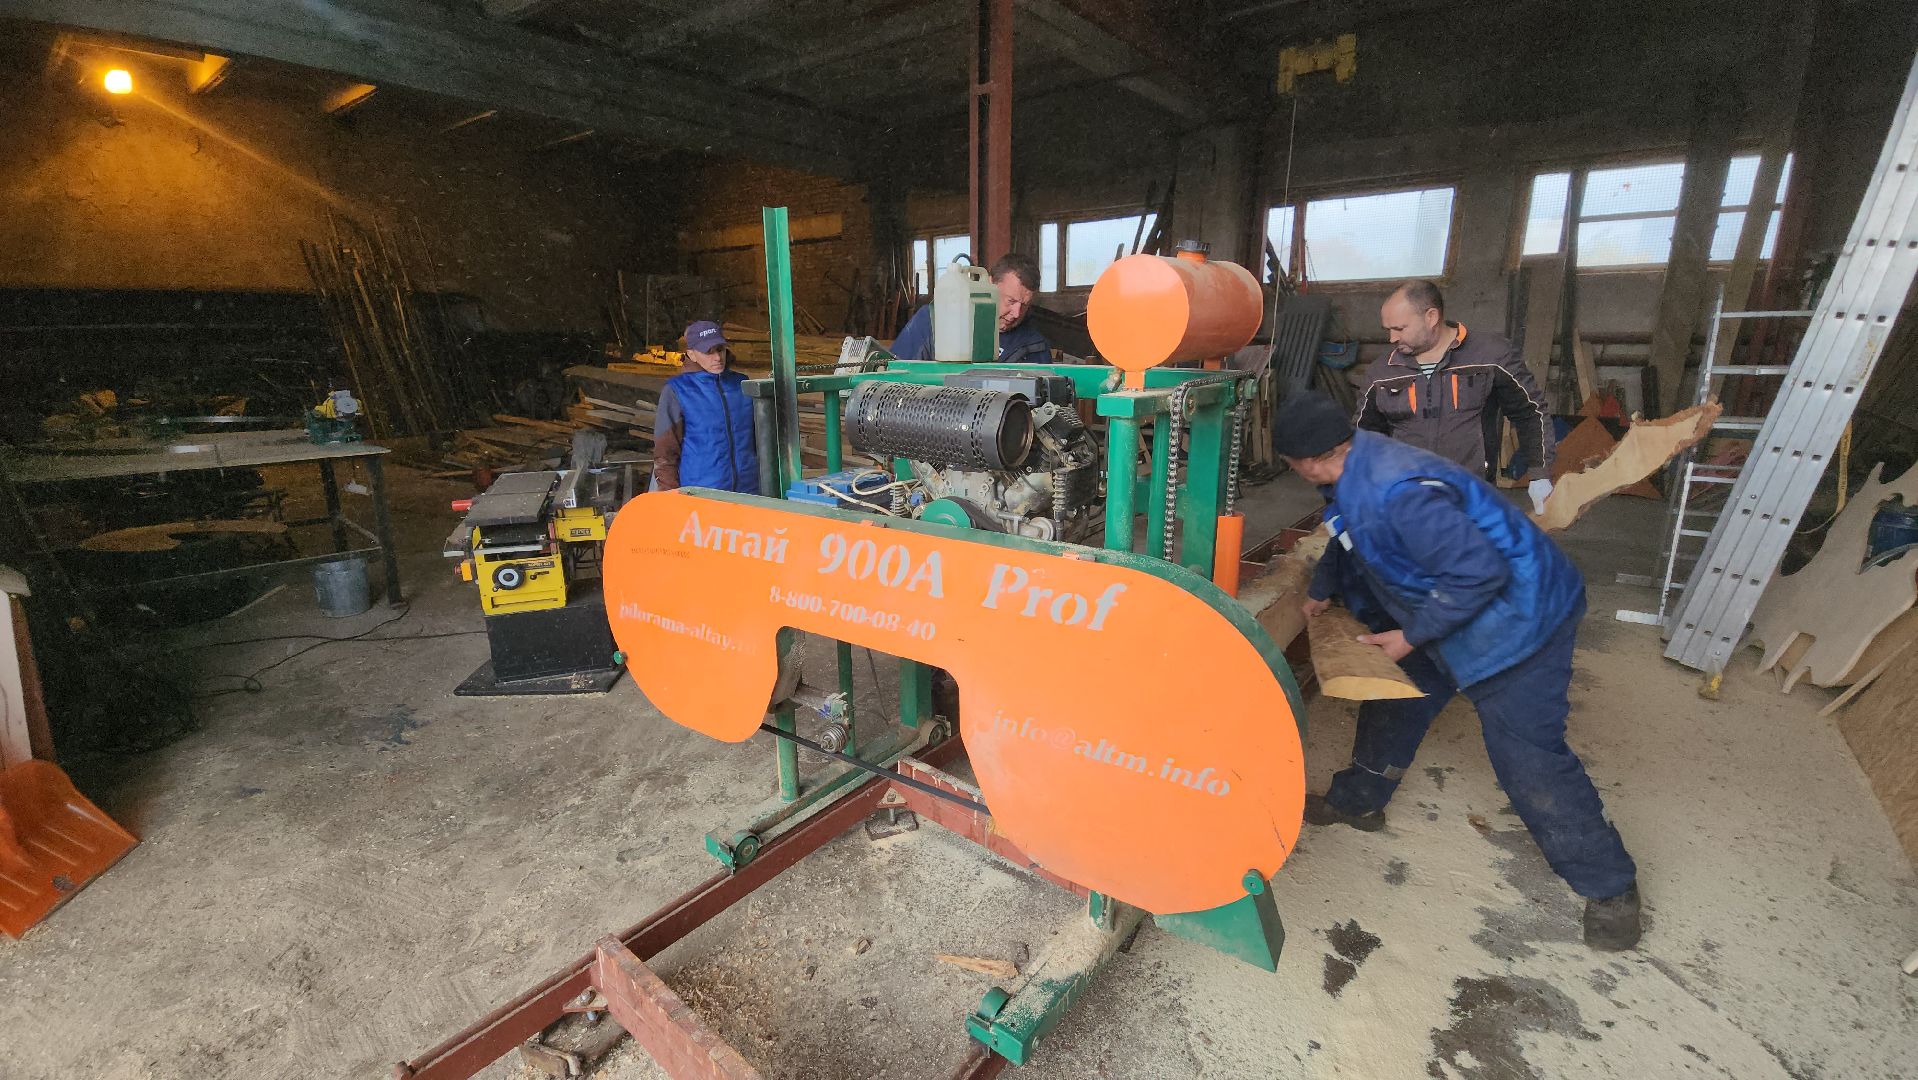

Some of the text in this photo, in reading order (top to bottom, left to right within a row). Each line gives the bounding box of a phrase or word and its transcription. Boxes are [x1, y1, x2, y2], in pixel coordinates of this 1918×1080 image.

[678, 510, 790, 564] Алтай
[981, 563, 1128, 631] Prof
[769, 585, 936, 641] 8-800-700-08-40
[993, 709, 1231, 797] info@altm.info
